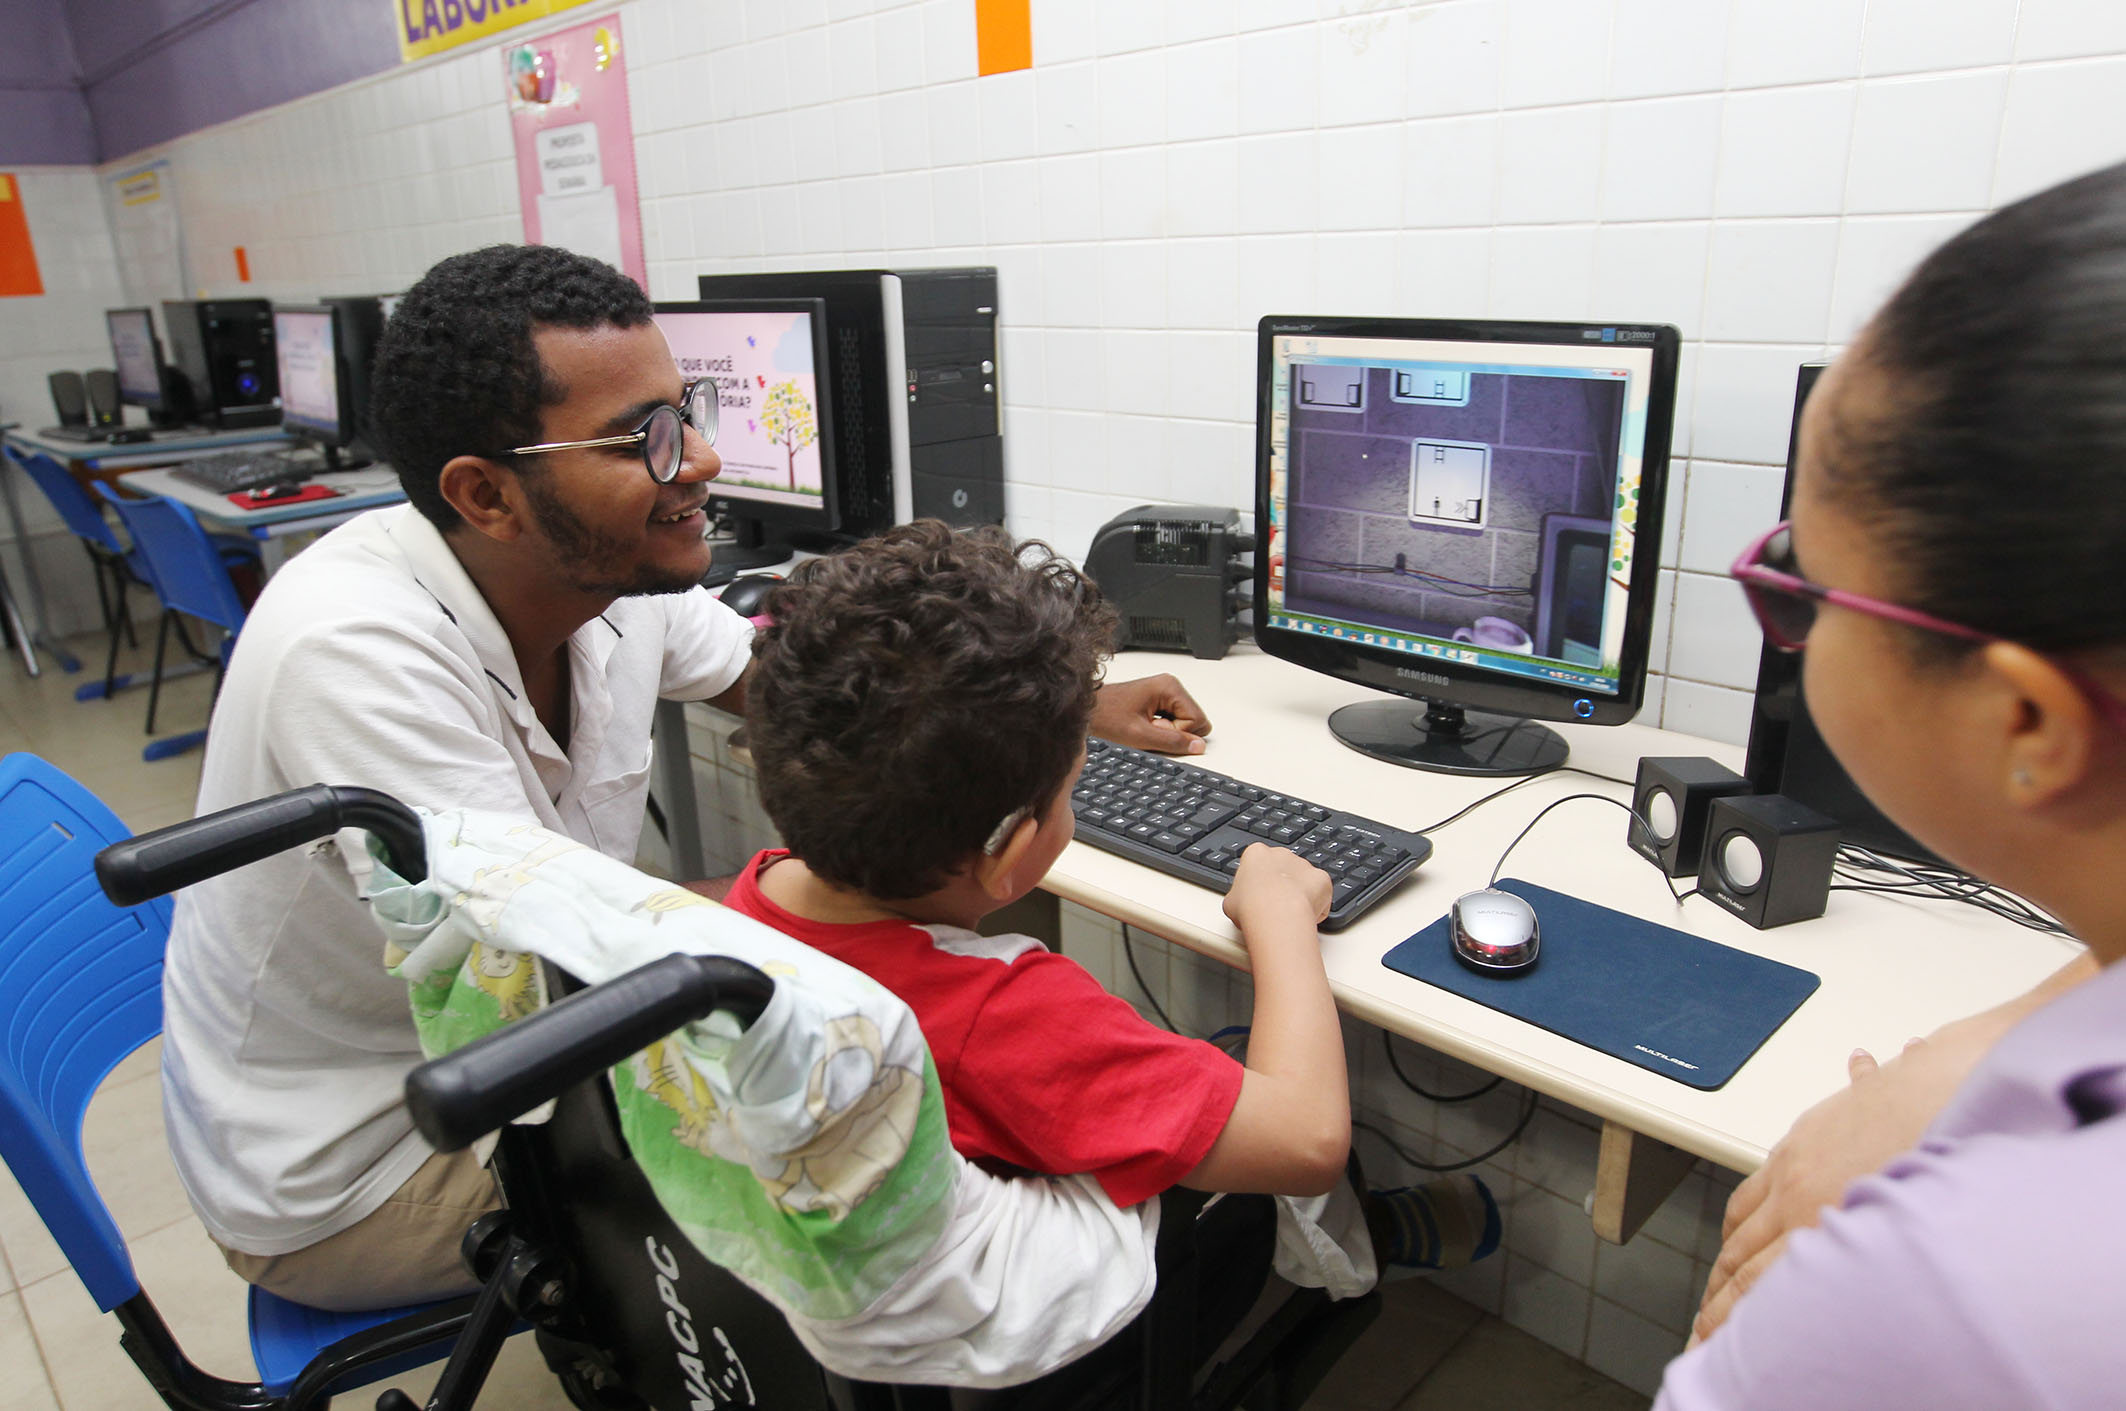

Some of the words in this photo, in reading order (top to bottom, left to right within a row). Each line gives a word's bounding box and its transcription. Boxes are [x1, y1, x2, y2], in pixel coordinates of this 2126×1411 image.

[719, 390, 752, 408] ÓRIA?
[1397, 667, 1449, 686] SAMSUNG
[1634, 1044, 1700, 1070] MULTILASER
